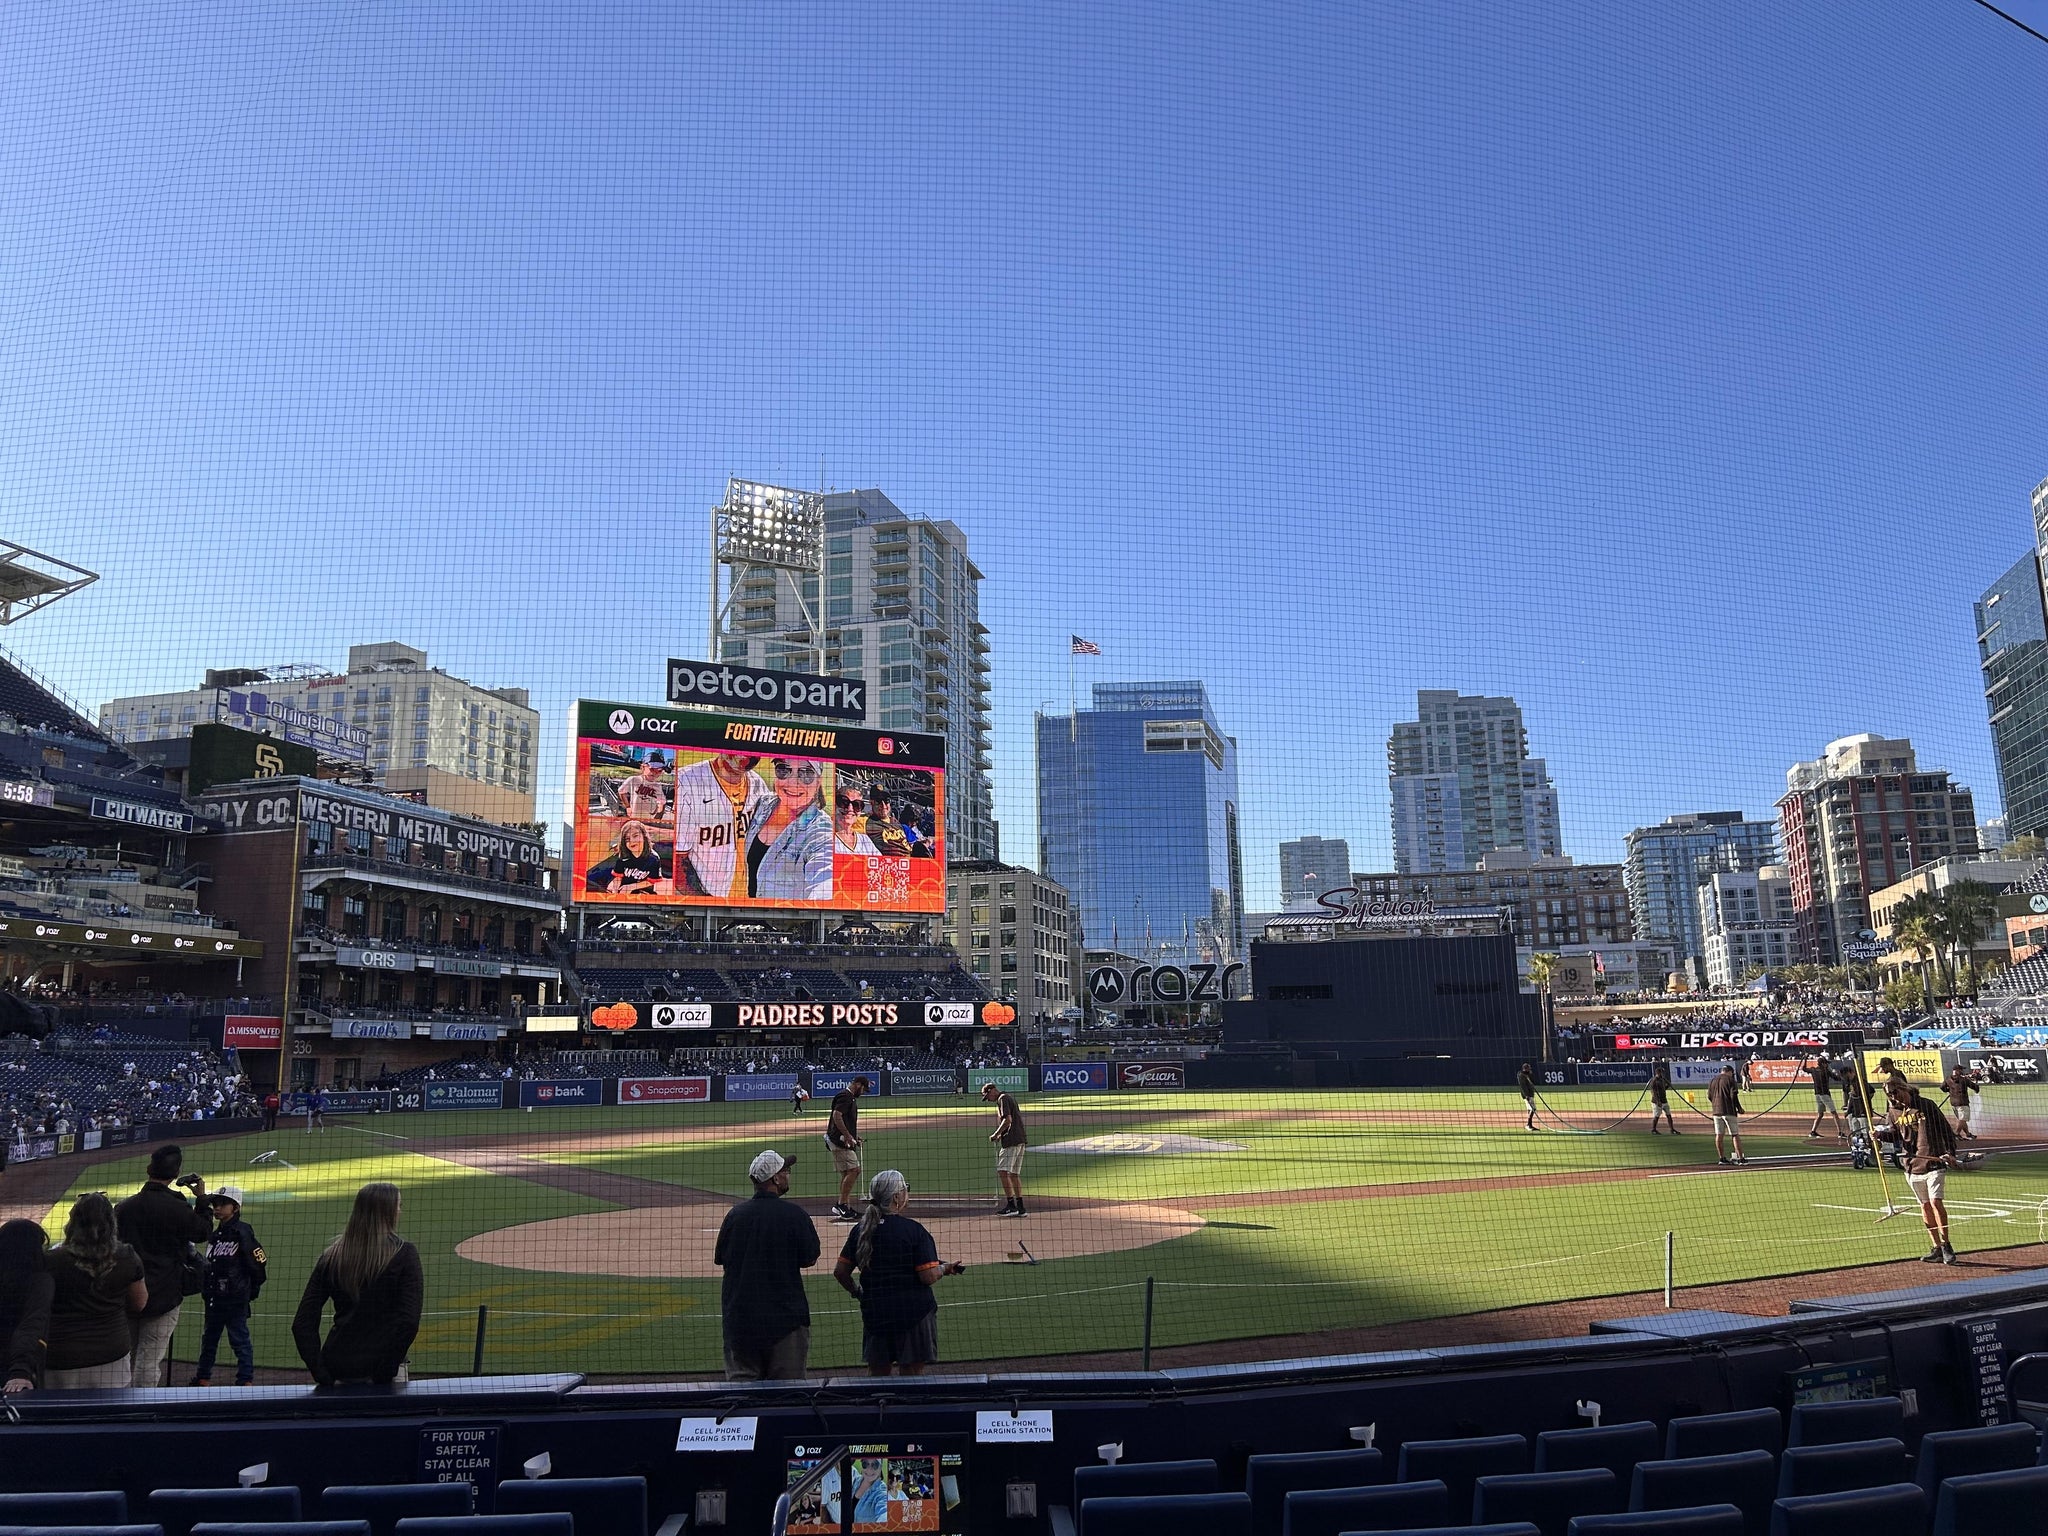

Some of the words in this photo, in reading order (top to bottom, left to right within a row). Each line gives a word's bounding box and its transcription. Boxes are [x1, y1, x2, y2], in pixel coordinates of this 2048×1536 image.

[671, 664, 778, 700] petco
[784, 680, 863, 711] park
[271, 701, 369, 745] QuidelOrtho
[640, 716, 678, 734] razr
[3, 782, 34, 804] 5:58
[105, 800, 185, 831] CUTWATER
[256, 797, 295, 825] CO.
[301, 793, 390, 835] WESTERN
[398, 817, 453, 849] METAL
[457, 829, 515, 861] SUPPLY
[519, 843, 543, 866] CO.
[1316, 887, 1440, 929] Sycuan
[1841, 940, 1893, 951] Gallagher
[361, 951, 396, 968] ORIS
[1850, 948, 1887, 959] Square
[1564, 968, 1578, 981] 19
[1130, 962, 1245, 1002] razr
[679, 1010, 707, 1021] razr
[737, 1004, 826, 1027] PADRES
[831, 1004, 899, 1025] POSTS
[947, 1006, 970, 1019] razr
[236, 1026, 266, 1035] MISSION
[267, 1027, 281, 1036] FED
[348, 1020, 399, 1038] Canel's
[445, 1024, 488, 1040] Canel's
[1632, 1037, 1668, 1046] TOYOTA
[1728, 1032, 1759, 1047] GO
[1761, 1030, 1829, 1047] PLACES
[292, 1040, 313, 1055] 336
[1044, 1070, 1089, 1084] ARCO
[1124, 1064, 1178, 1087] Sycuan
[1544, 1070, 1564, 1084] 396
[1584, 1069, 1594, 1077] UC
[1594, 1069, 1606, 1077] San
[1606, 1069, 1626, 1079] Diego
[1626, 1069, 1647, 1077] Health
[1772, 1070, 1795, 1078] Safari
[742, 1081, 795, 1092] QuidelOrtho
[975, 1075, 1021, 1086] dexcom
[447, 1086, 499, 1098] Palomar
[538, 1088, 553, 1097] us
[555, 1085, 585, 1097] bank
[647, 1084, 701, 1096] Snapdragon
[396, 1093, 420, 1109] 342
[431, 1097, 464, 1106] SPECIALTY
[464, 1096, 499, 1105] INSURANCE
[1972, 1325, 1983, 1334] FOR
[1982, 1322, 1997, 1332] YOUR
[1972, 1345, 1986, 1355] STAY
[1986, 1342, 2003, 1352] CLEAR
[1980, 1355, 1988, 1364] OF
[1987, 1353, 1998, 1362] ALL
[1979, 1363, 2001, 1375] NETTING
[1980, 1386, 1994, 1396] PLAY
[432, 1432, 454, 1442] FOR
[456, 1431, 486, 1441] YOUR
[679, 1435, 719, 1443] CHARGING
[720, 1434, 754, 1442] STATION
[435, 1444, 481, 1456] SAFETY,
[806, 1446, 823, 1455] razr
[424, 1459, 453, 1470] STAY
[455, 1458, 491, 1469] CLEAR
[438, 1473, 453, 1483] OF
[455, 1472, 476, 1482] ALL
